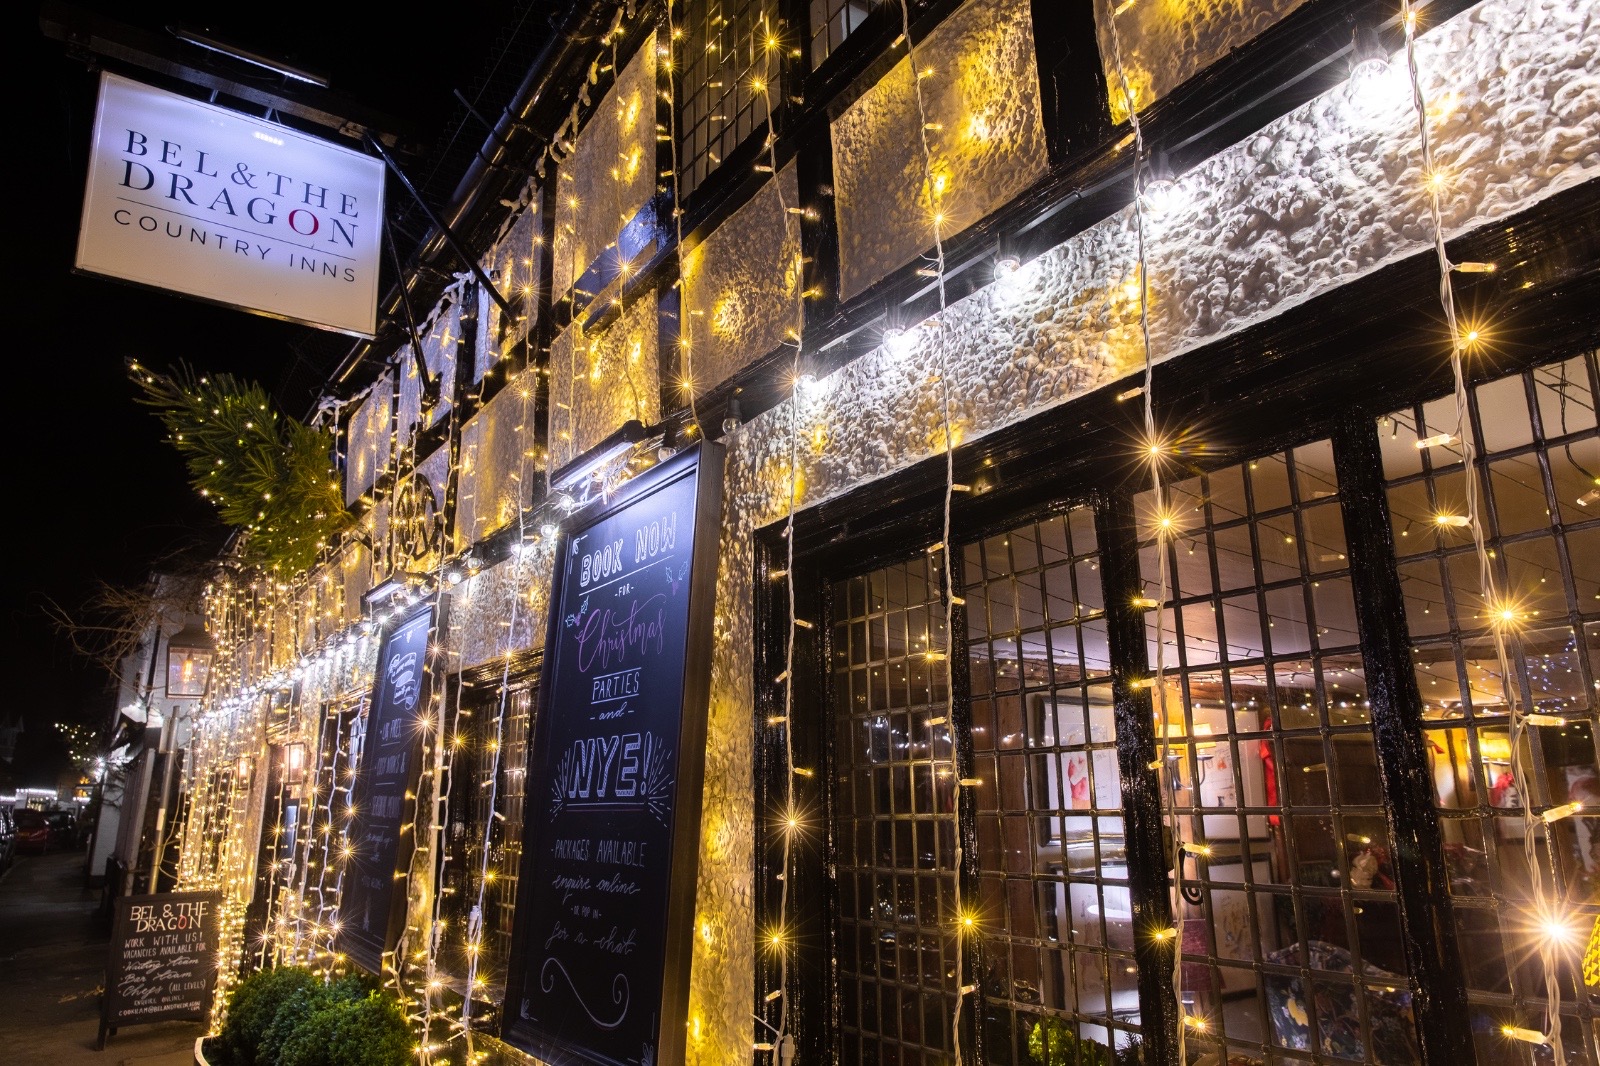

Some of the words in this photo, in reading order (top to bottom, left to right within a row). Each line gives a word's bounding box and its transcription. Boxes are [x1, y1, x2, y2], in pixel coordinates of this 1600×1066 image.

[122, 128, 218, 178] BEL
[230, 162, 258, 189] &
[266, 171, 359, 218] THE
[118, 158, 359, 248] DRAGON
[113, 209, 271, 261] COUNTRY
[290, 253, 356, 283] INNS
[579, 538, 624, 587] BOOK
[634, 512, 677, 563] NOW
[575, 593, 667, 673] Christmas
[592, 671, 640, 700] PARTIES
[568, 731, 652, 799] NYE!
[596, 839, 647, 868] AVAILABLE
[552, 874, 591, 905] enquire
[596, 872, 641, 895] online
[130, 905, 157, 921] BEL
[162, 904, 174, 918] &
[177, 901, 209, 917] THE
[136, 915, 201, 933] DRAGON
[123, 947, 157, 959] VACANCIES
[160, 944, 192, 956] AVAILABLE
[195, 942, 207, 951] FOR
[124, 938, 145, 949] WORK
[153, 934, 179, 946] WITH
[185, 931, 203, 943] US!
[545, 920, 569, 950] for
[574, 932, 588, 945] a
[593, 925, 637, 955] chat
[124, 959, 165, 975] Waiting
[122, 984, 163, 1000] Chefs
[168, 981, 181, 995] (ALL
[183, 979, 207, 991] LEVELS)
